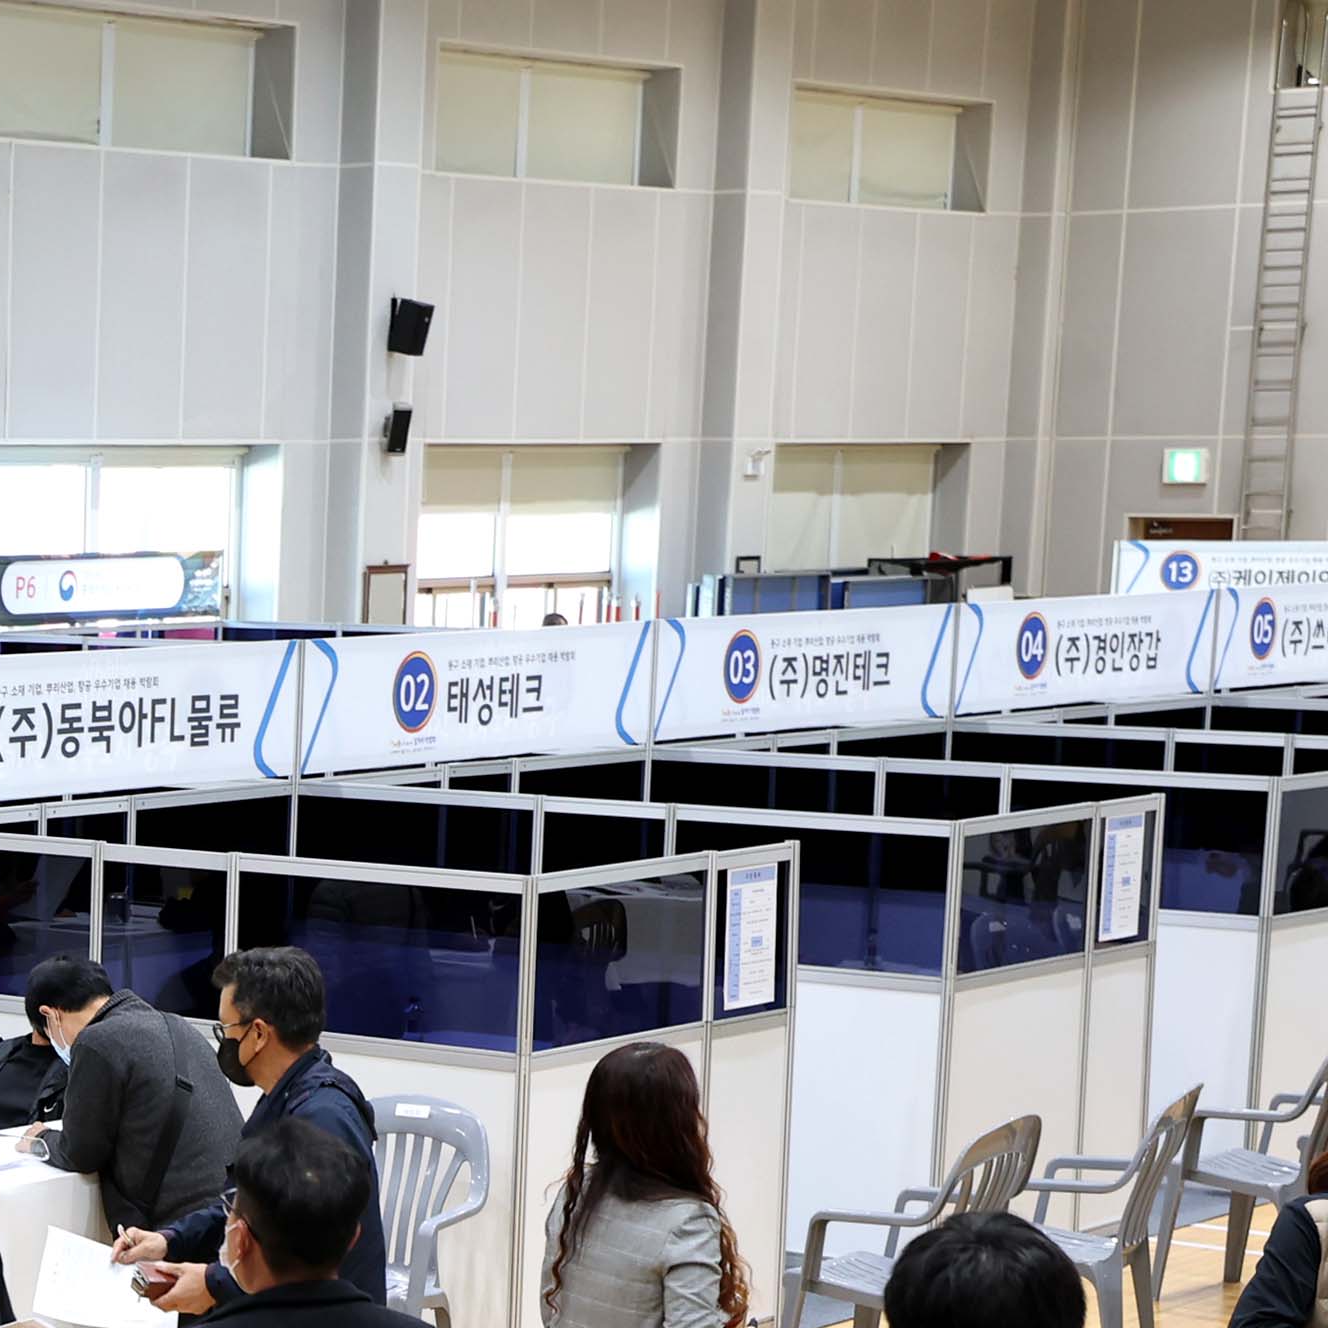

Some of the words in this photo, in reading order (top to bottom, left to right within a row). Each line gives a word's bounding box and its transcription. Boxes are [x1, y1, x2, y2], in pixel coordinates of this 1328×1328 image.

[15, 575, 37, 600] P6
[1168, 561, 1193, 584] 13
[1021, 629, 1044, 663] 04
[1252, 613, 1274, 645] 05
[1281, 616, 1328, 658] (주)쓰
[729, 649, 756, 685] 03
[1055, 628, 1162, 677] (주)경인장갑
[400, 672, 430, 713] 02
[769, 650, 891, 700] (주)명진테크
[447, 672, 544, 726] 태성테크
